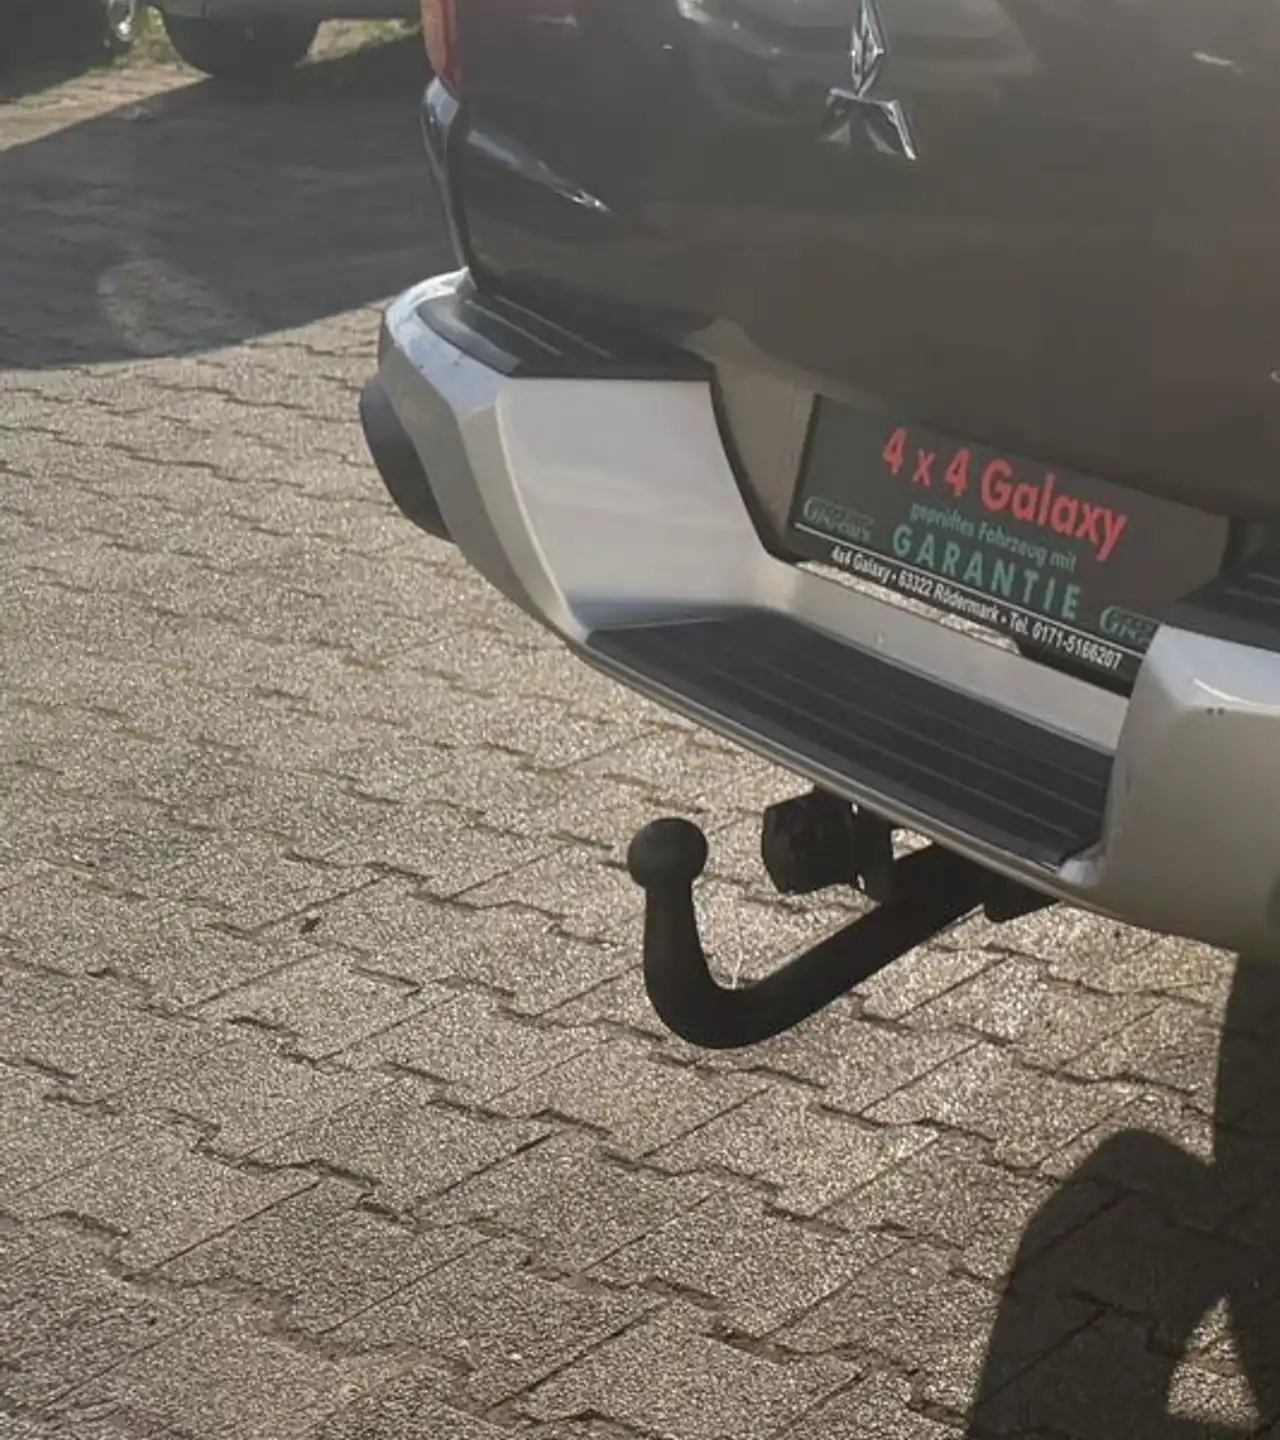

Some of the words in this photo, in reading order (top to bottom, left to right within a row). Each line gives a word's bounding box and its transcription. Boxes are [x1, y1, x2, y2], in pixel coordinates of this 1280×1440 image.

[882, 425, 909, 476] 4
[944, 447, 971, 497] 4
[979, 457, 1129, 562] Galaxy
[852, 552, 892, 585] Galaxy
[893, 523, 1081, 620] GARANTIE
[978, 520, 1048, 568] Fahrzeug
[1050, 550, 1077, 572] mit
